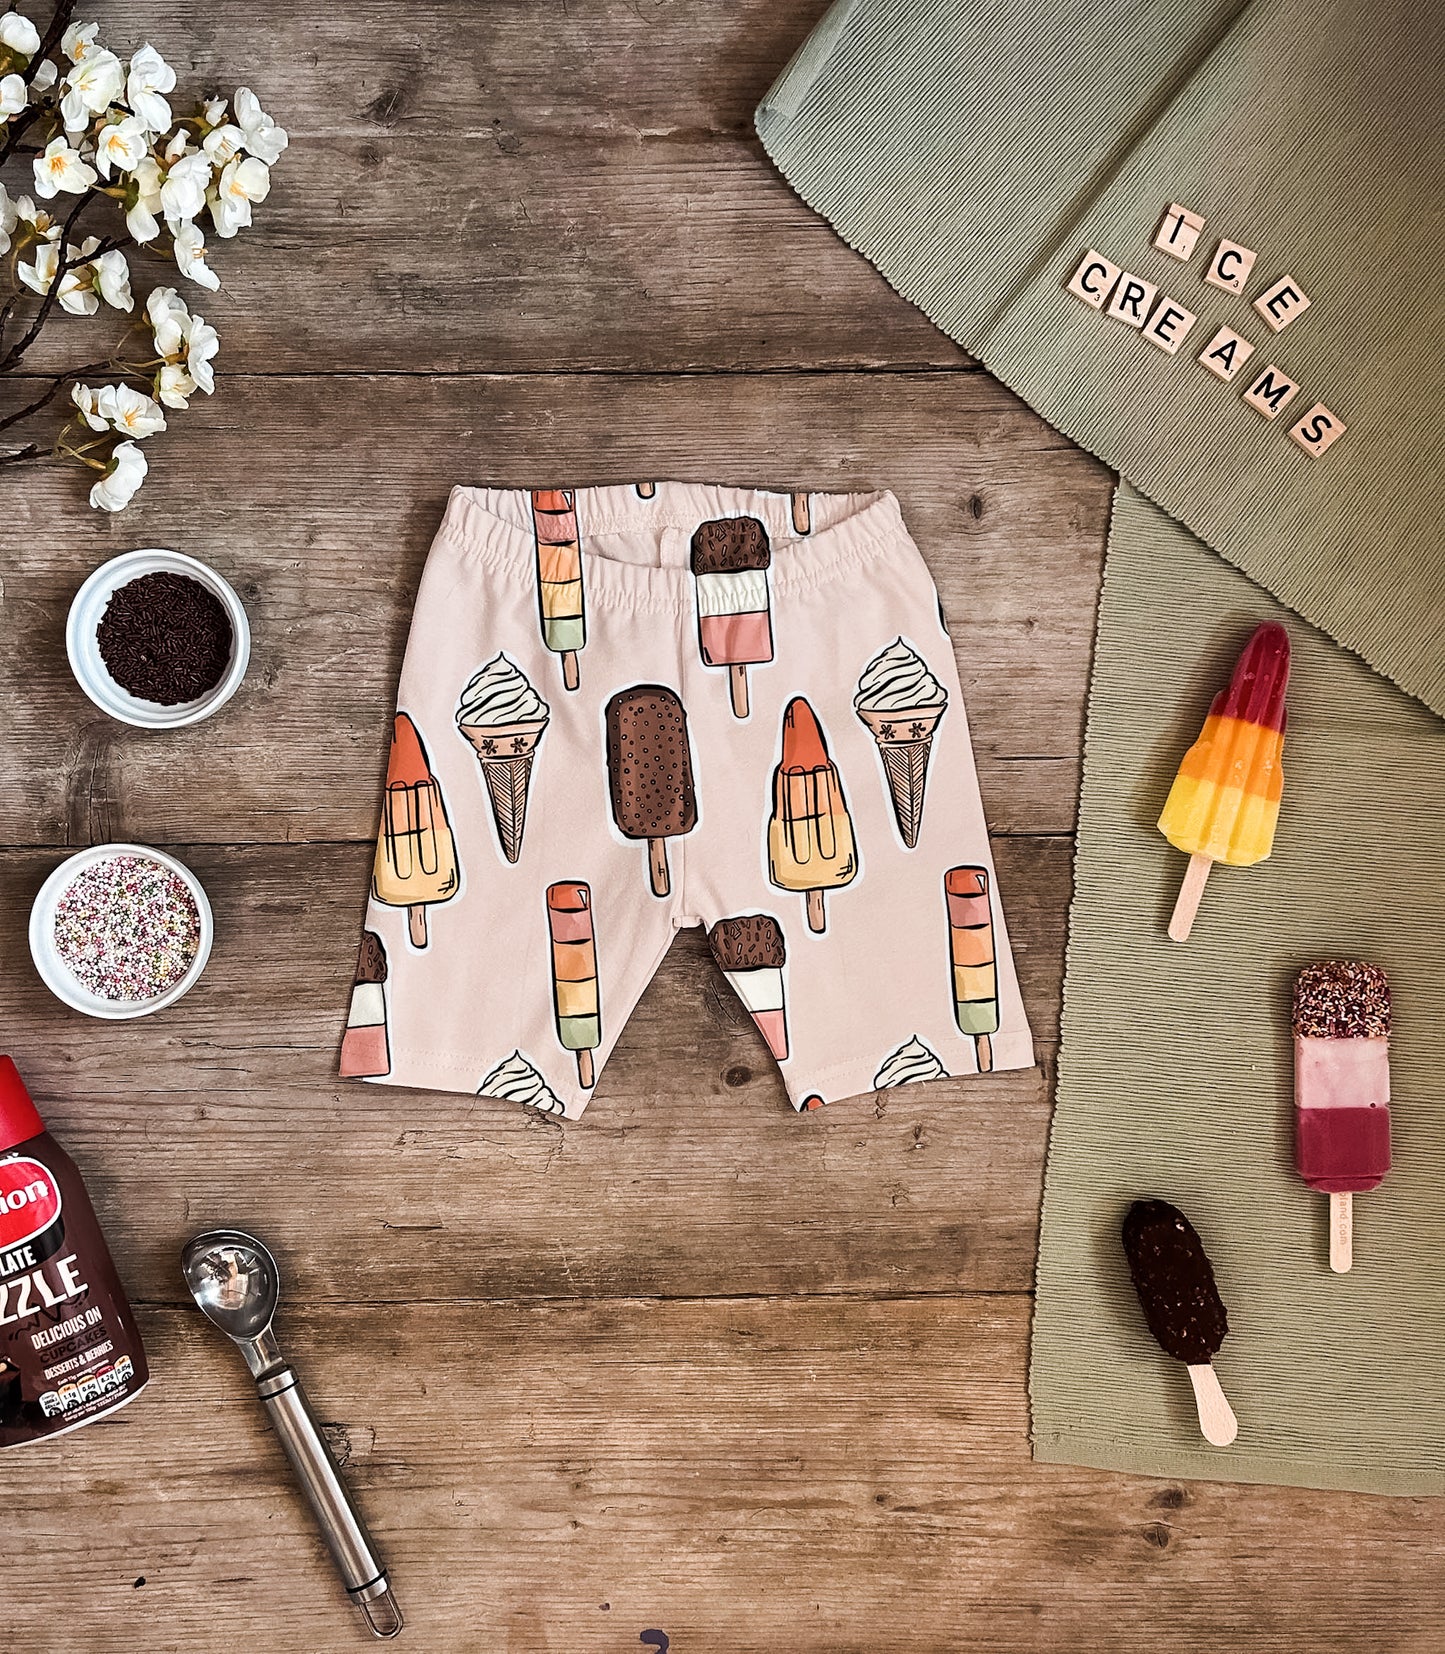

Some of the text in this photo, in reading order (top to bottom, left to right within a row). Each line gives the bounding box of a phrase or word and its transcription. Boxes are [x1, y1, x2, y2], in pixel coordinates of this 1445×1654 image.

[1169, 214, 1300, 319] ICE
[0, 1245, 37, 1277] LATE
[31, 1306, 103, 1350] DELICIOUS ON
[41, 1326, 107, 1363] CUPCAKES
[44, 1357, 79, 1380] DESSERTS
[78, 1354, 87, 1365] &
[84, 1340, 114, 1362] BERRIES
